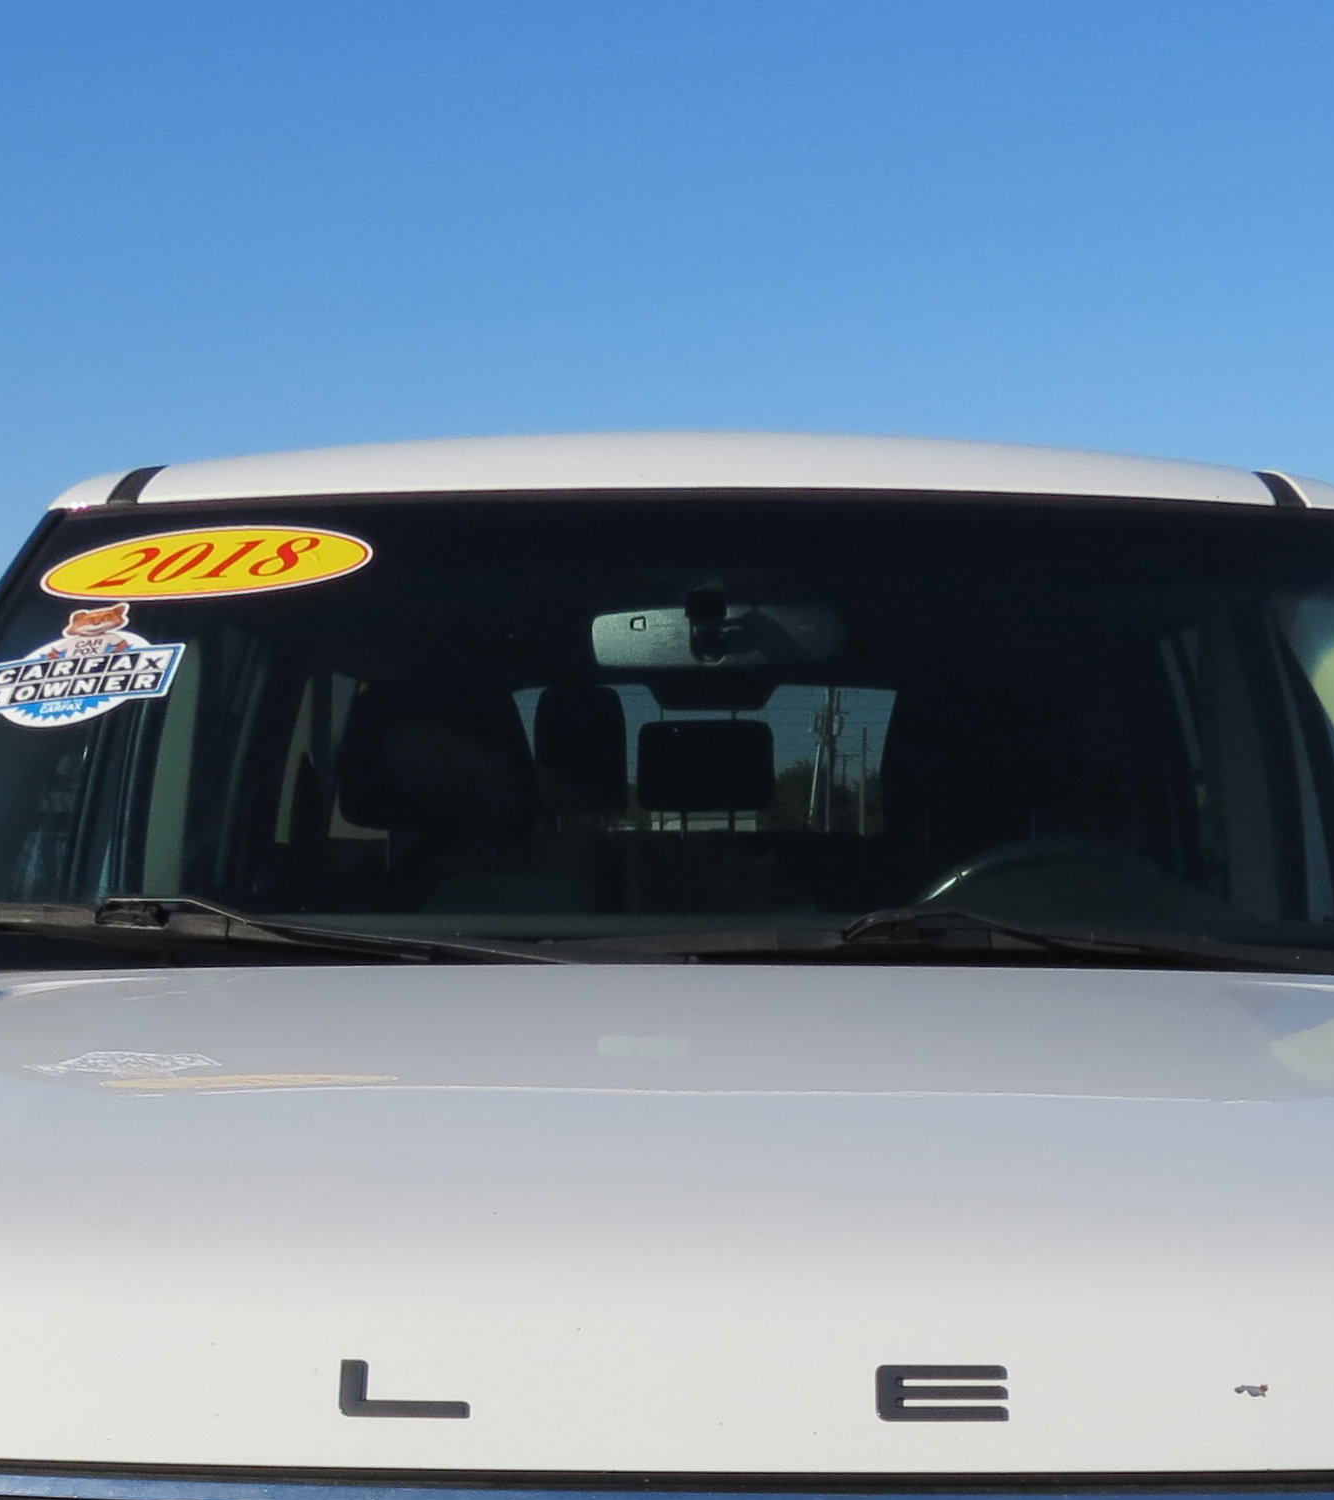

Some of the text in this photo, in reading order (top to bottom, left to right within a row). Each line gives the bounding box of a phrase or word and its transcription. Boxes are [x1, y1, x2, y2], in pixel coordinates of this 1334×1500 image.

[86, 537, 321, 589] 2018
[75, 638, 103, 648] CAR
[16, 672, 156, 702] OWNER
